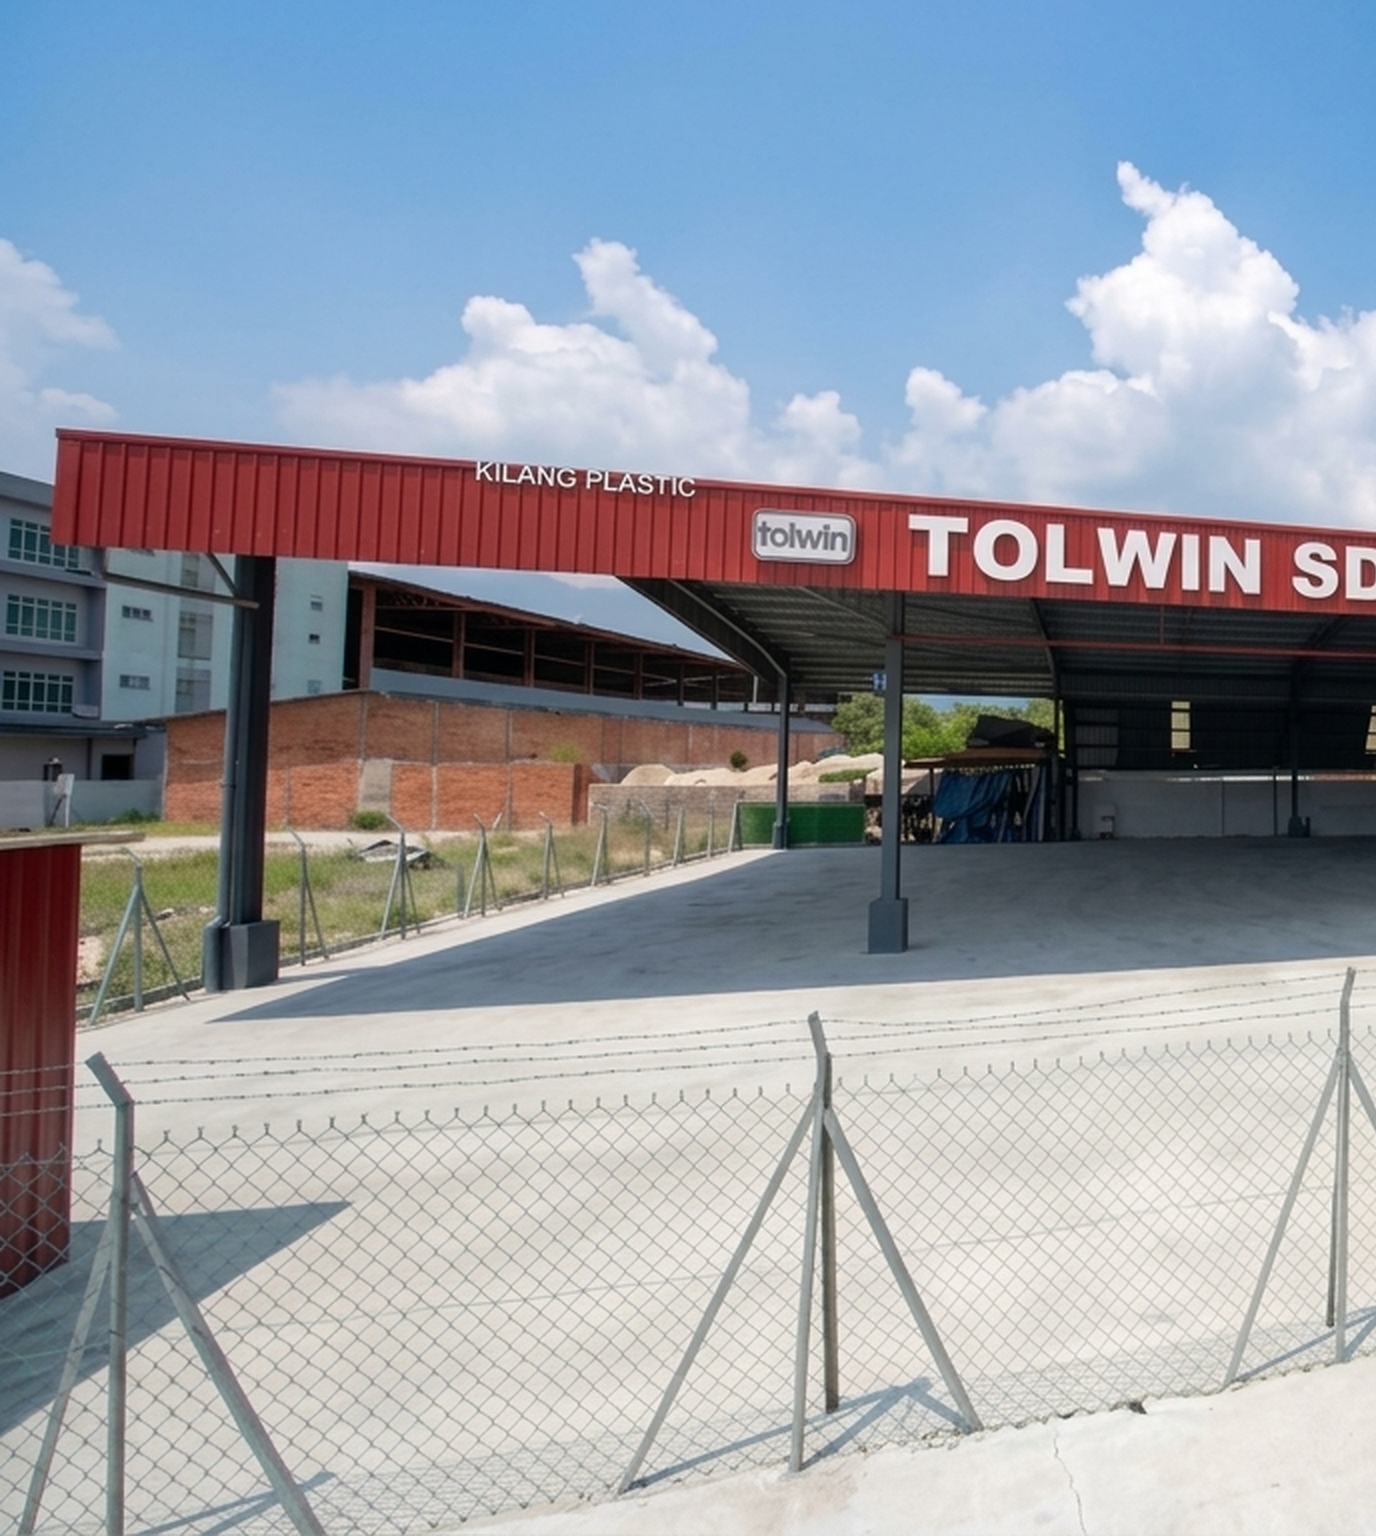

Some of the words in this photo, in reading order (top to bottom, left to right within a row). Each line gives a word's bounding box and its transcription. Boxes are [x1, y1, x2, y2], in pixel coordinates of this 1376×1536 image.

[475, 461, 577, 488] KILANG
[585, 470, 696, 497] PLASTIC
[757, 520, 848, 552] tolwin
[908, 515, 1261, 595] TOLWIN
